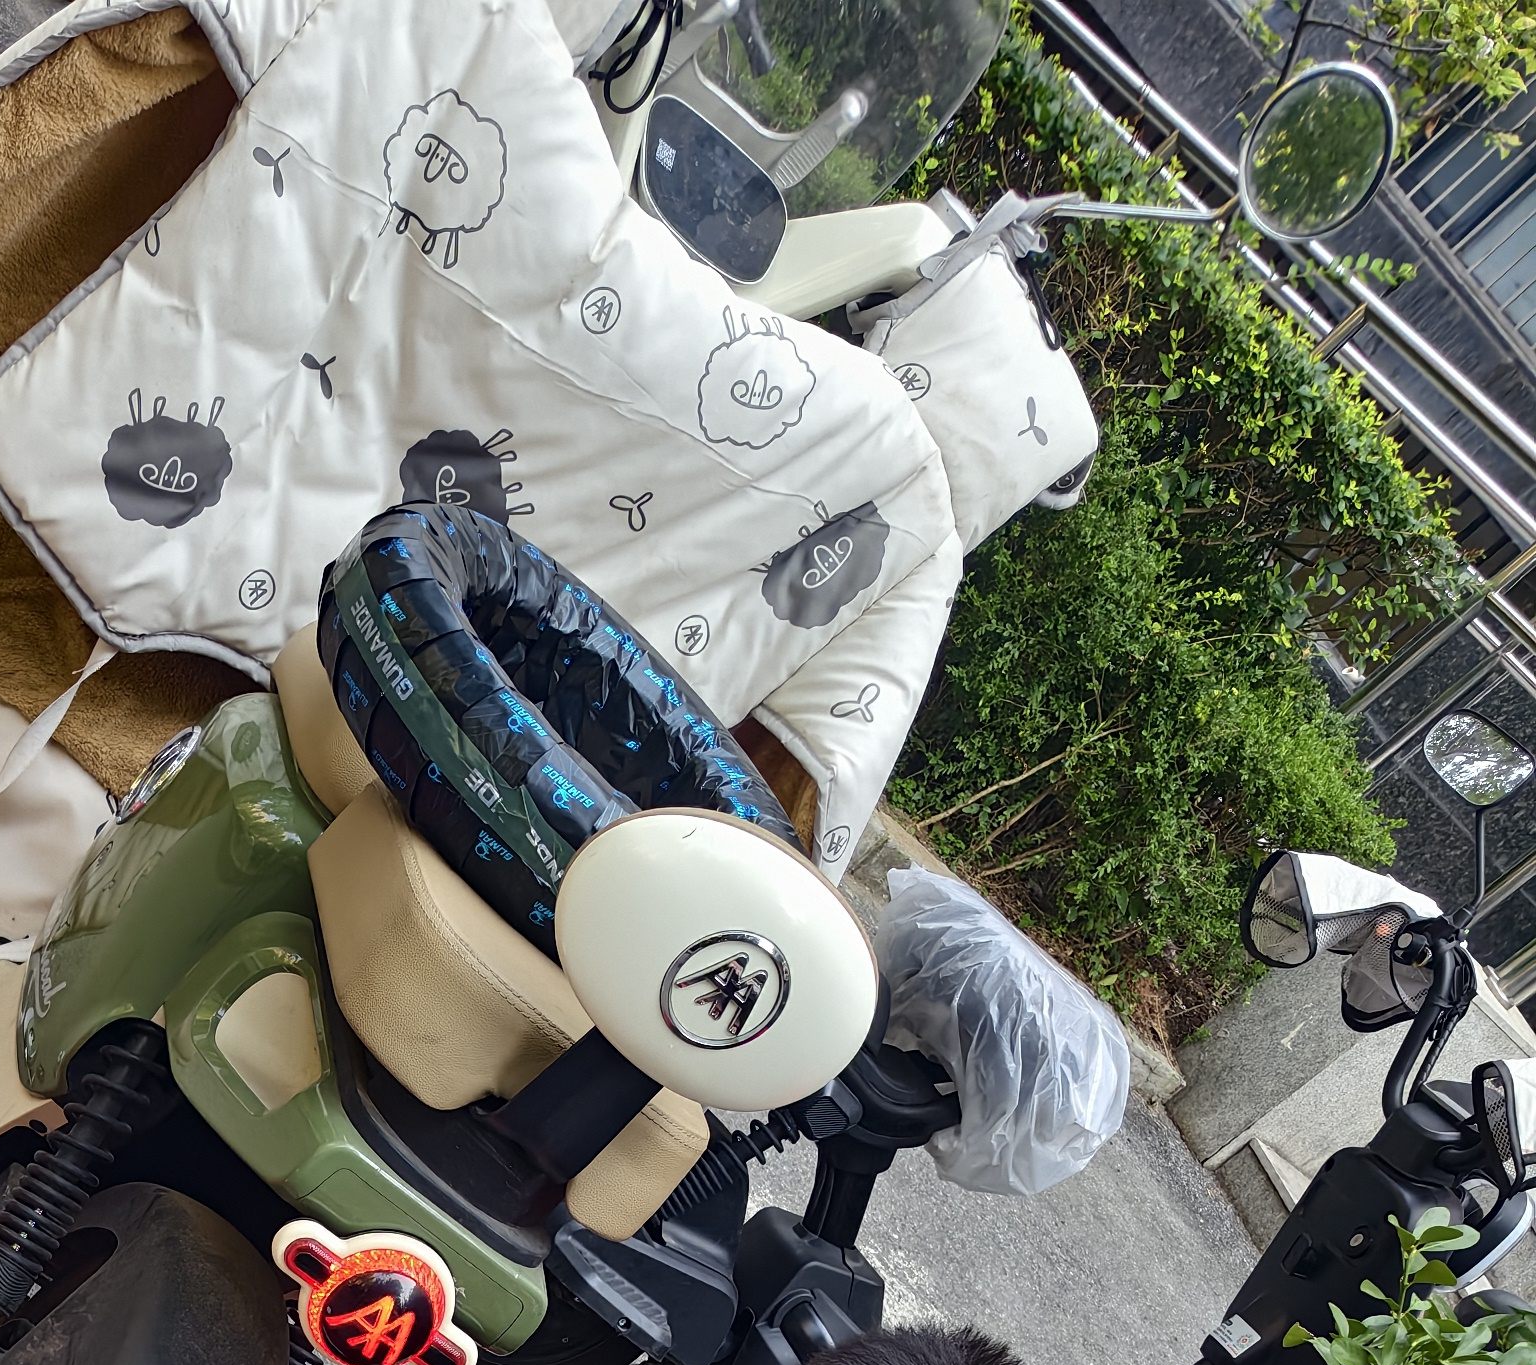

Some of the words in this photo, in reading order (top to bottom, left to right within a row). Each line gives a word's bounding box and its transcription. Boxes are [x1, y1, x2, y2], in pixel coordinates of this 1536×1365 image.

[350, 595, 415, 701] GUMANDE
[499, 692, 549, 738] GUMANDE
[541, 764, 595, 810] GUMANDE
